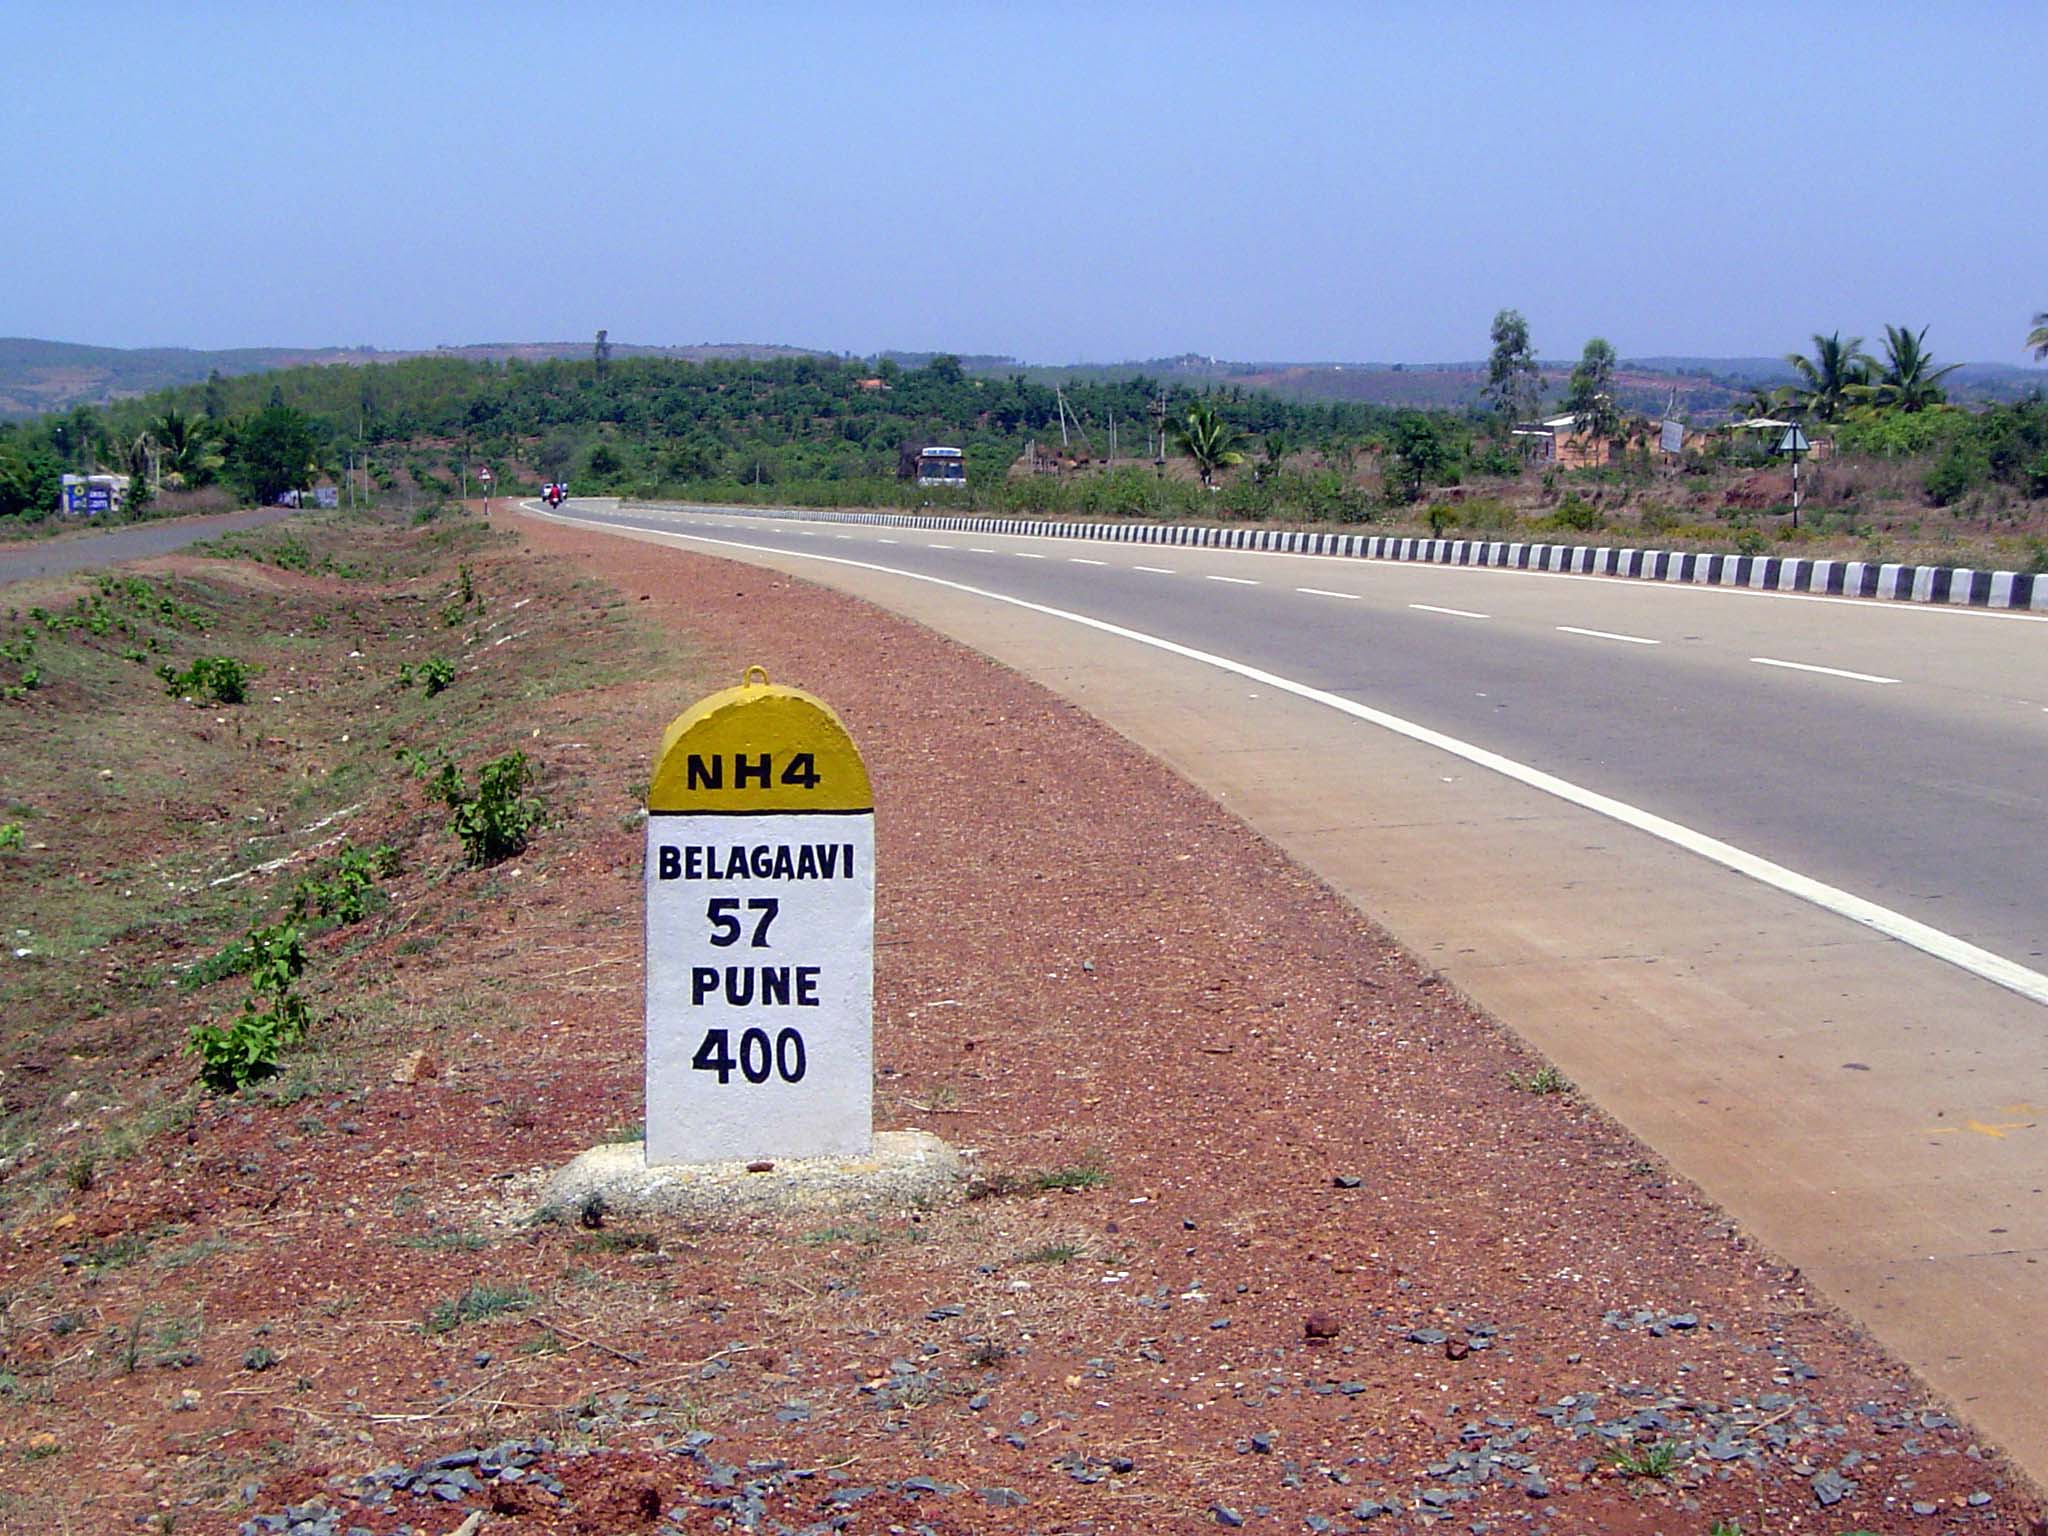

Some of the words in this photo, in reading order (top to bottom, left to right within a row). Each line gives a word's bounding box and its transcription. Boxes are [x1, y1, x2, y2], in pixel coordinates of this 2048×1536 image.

[687, 753, 821, 791] NH4
[659, 844, 854, 881] BELAGAAVI
[706, 898, 780, 948] 57
[692, 967, 821, 1007] PUNE
[692, 1028, 807, 1084] 400
